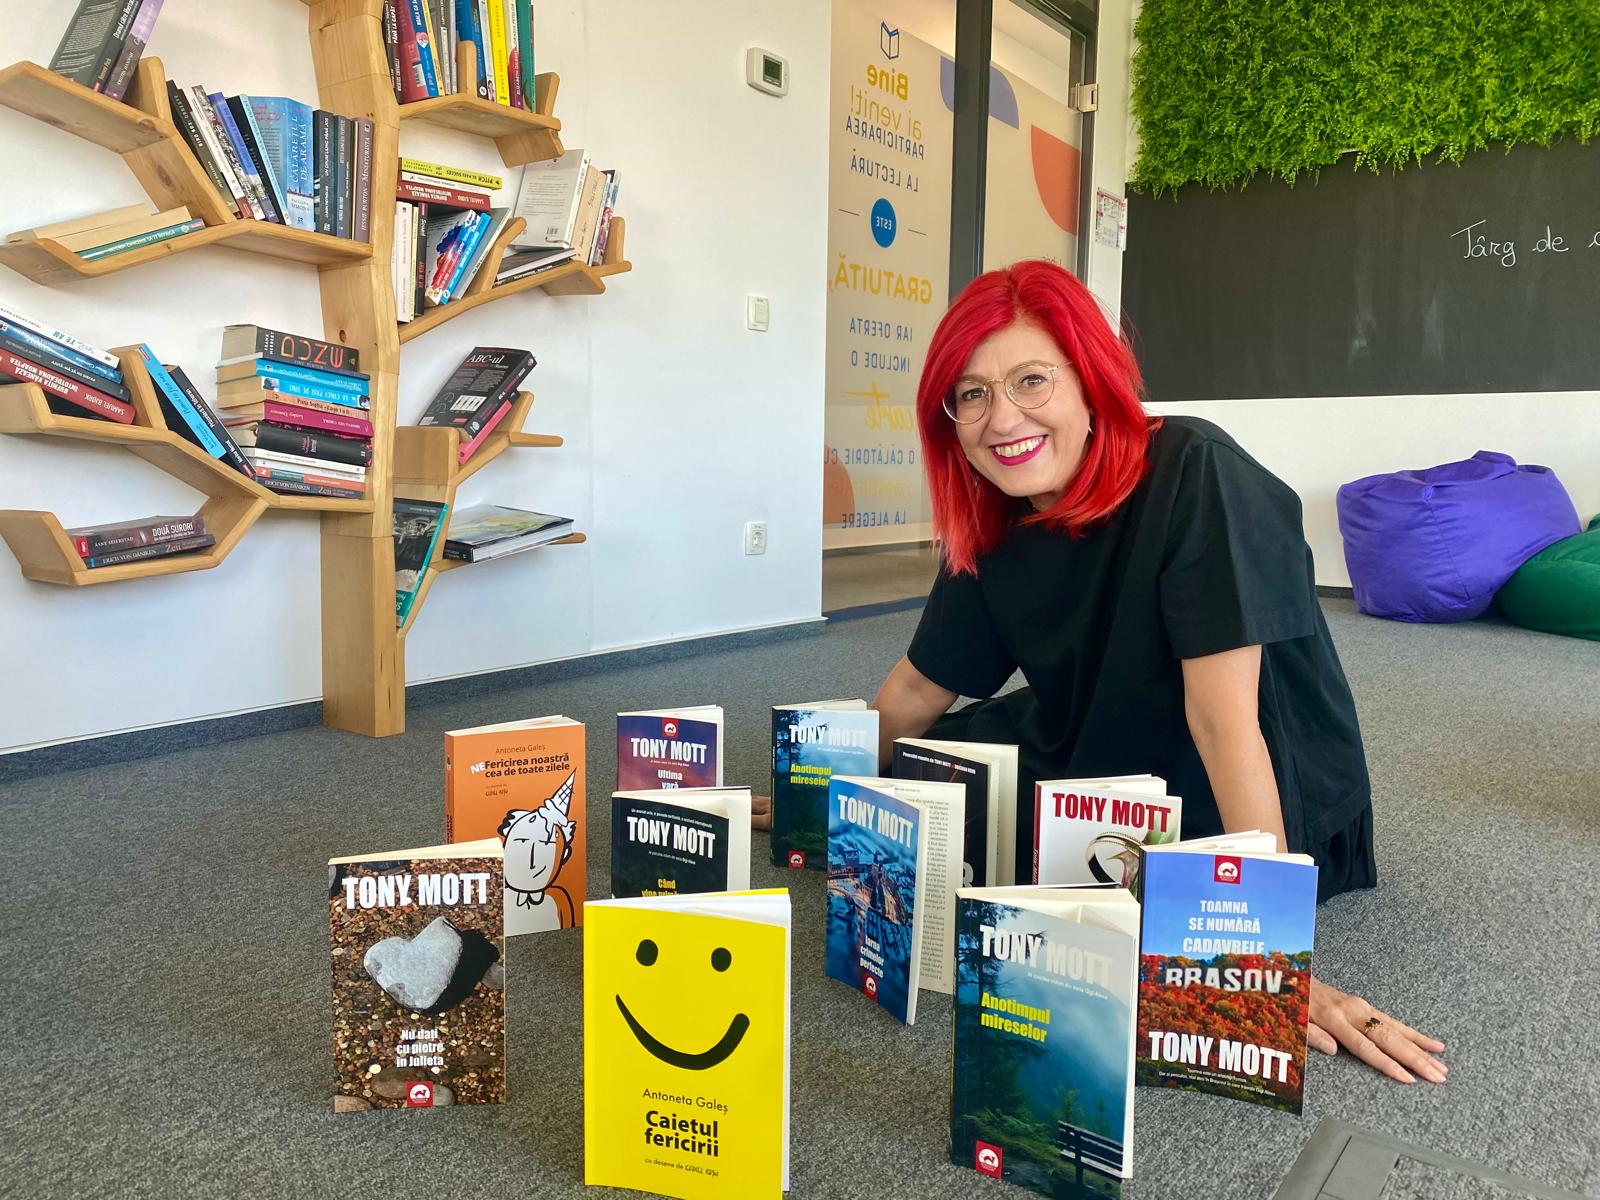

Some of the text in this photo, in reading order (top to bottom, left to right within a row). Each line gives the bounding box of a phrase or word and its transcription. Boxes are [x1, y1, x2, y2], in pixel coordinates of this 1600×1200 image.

[1449, 219, 1569, 268] Târg de
[467, 355, 505, 364] ABC-ul
[171, 522, 193, 534] SURORI
[788, 724, 867, 748] TONY MOTT
[495, 745, 526, 755] Antoneta
[530, 752, 569, 765] noastră
[630, 737, 707, 764] TONY MOTT
[485, 762, 570, 778] cea de toate zilele
[657, 769, 683, 781] Ultima
[790, 763, 832, 776] Anotimpul
[790, 775, 830, 787] mireselor
[837, 793, 914, 849] TONY MOTT
[1052, 792, 1171, 833] TONY MOTT
[626, 816, 670, 847] TONY
[673, 823, 716, 859] MOTT
[341, 872, 491, 910] TONY MOTT
[657, 878, 676, 889] Când
[1200, 900, 1249, 914] TOAMNA
[1188, 917, 1261, 934] SE NUMĂRĂ
[865, 935, 881, 953] Iarna
[1183, 937, 1265, 954] CADAVRELE
[980, 924, 1113, 988] TONY MOTT
[981, 991, 1050, 1025] Anotimpul
[401, 1029, 416, 1040] Nu
[981, 1012, 1047, 1043] mireselor
[396, 1042, 444, 1055] cu pietre
[408, 1055, 444, 1067] Julieta
[1148, 1031, 1293, 1084] TONY MOTT
[642, 1088, 728, 1115] Antoneta Galeș
[645, 1110, 718, 1138] Caietul
[644, 1127, 719, 1157] fericirii
